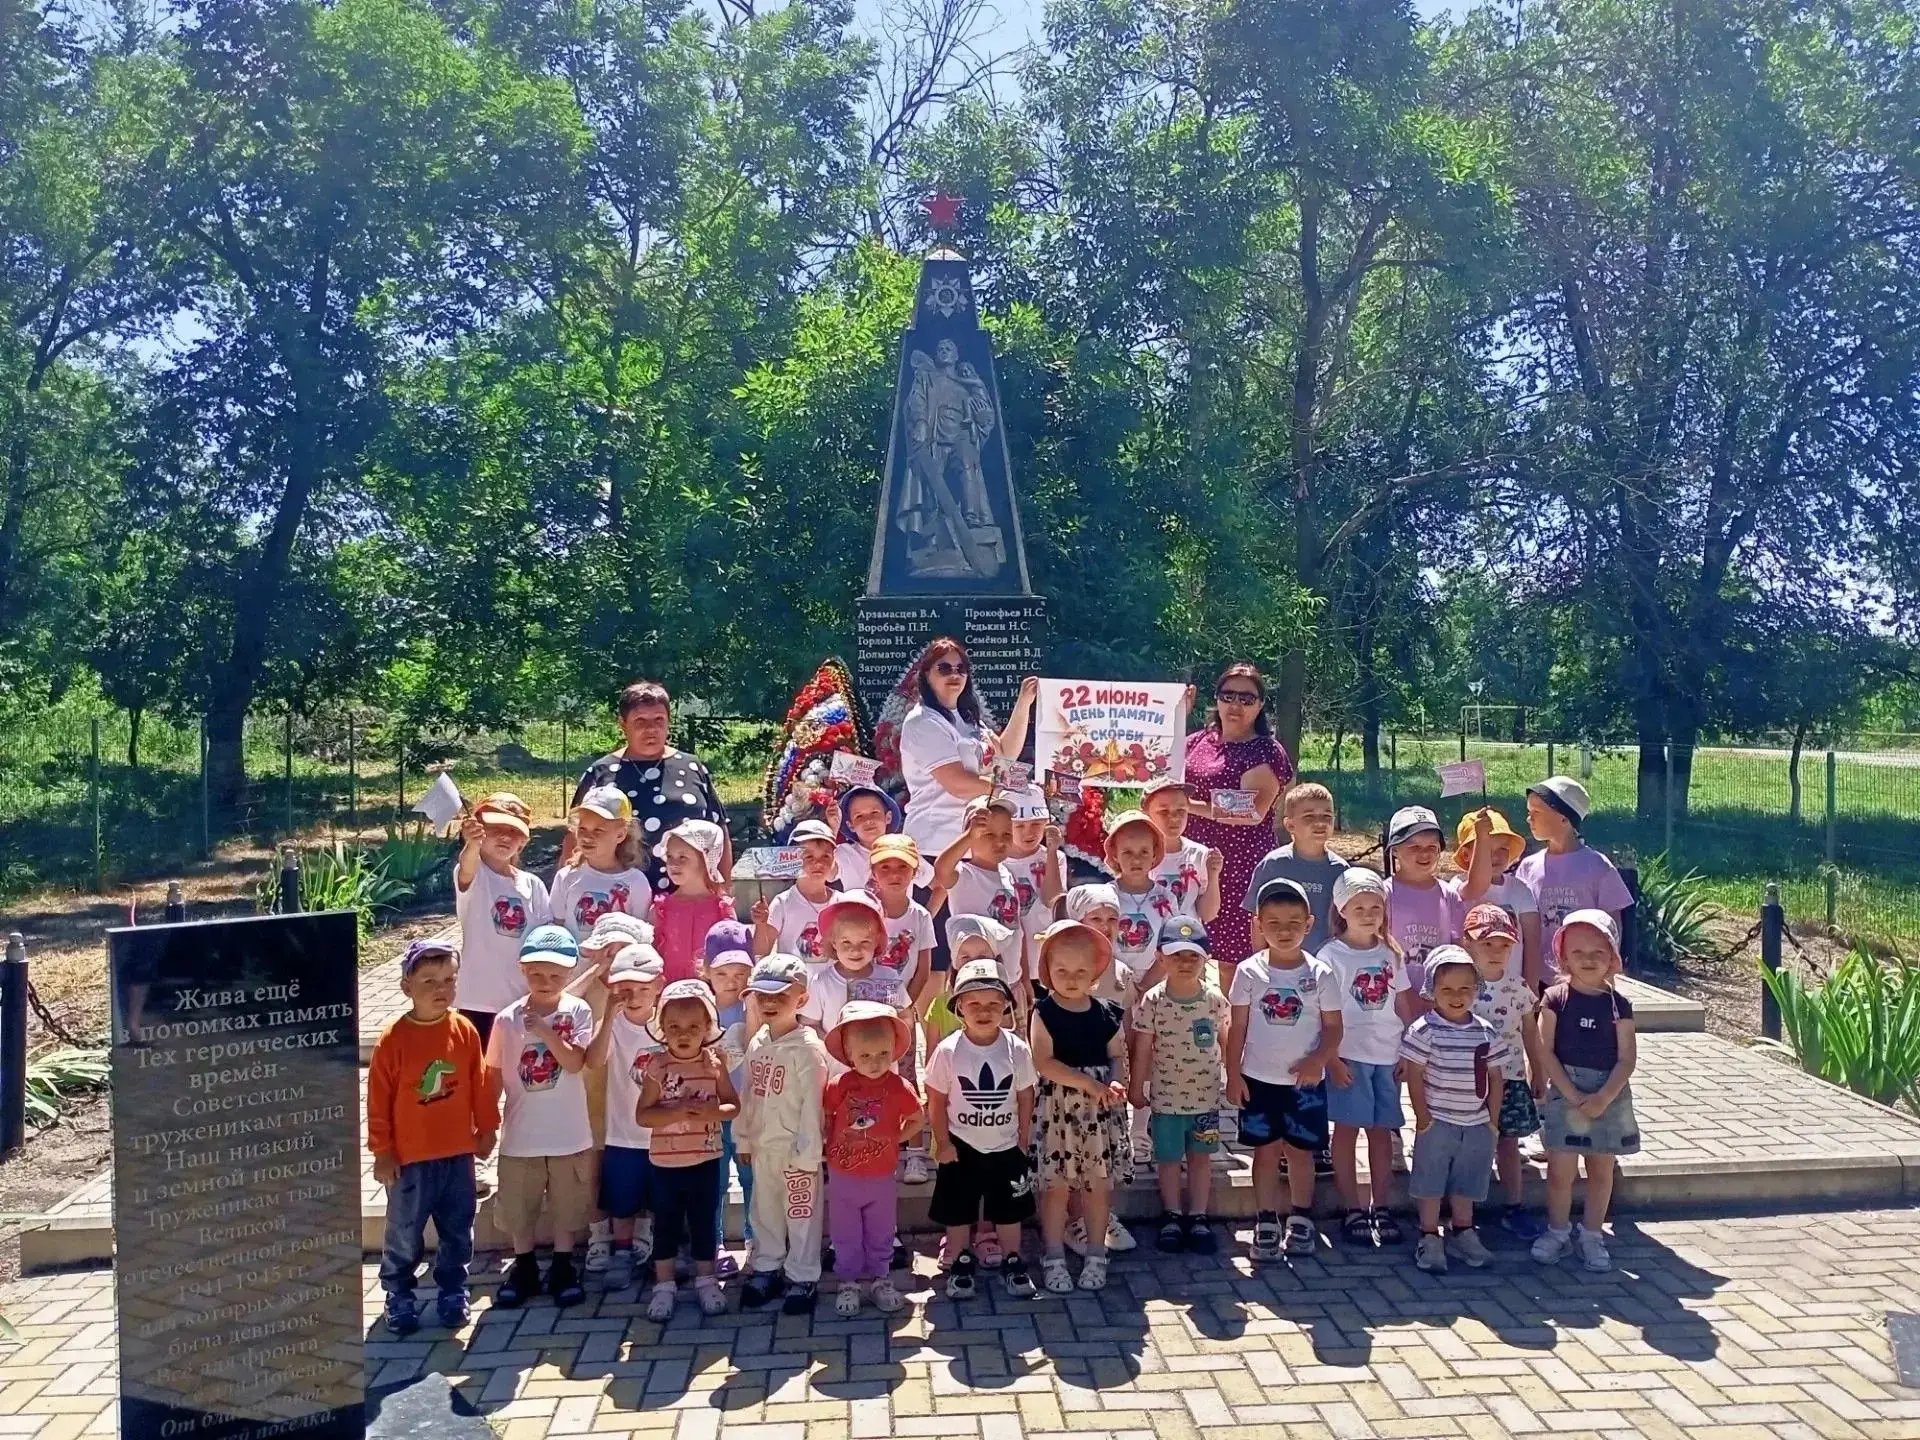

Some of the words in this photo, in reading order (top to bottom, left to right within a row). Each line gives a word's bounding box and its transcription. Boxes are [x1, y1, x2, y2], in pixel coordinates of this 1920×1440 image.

[857, 610, 918, 620] Арзамасцев
[919, 609, 941, 619] В.А.
[964, 608, 1021, 620] Прокофьев
[1022, 607, 1046, 618] Н.С.
[857, 622, 906, 634] Воробьёв
[907, 622, 932, 633] П.Н.
[964, 622, 1006, 632] Редькин
[1008, 621, 1031, 631] Н.С.
[857, 636, 893, 648] Горлов
[894, 636, 917, 646] Н.К.
[964, 635, 1008, 645] Семёнов
[1010, 635, 1033, 645] Н.А.
[857, 650, 907, 661] Долматов
[1023, 648, 1044, 659] В.Д.
[971, 662, 1017, 674] ретьяков
[1019, 661, 1042, 671] Н.С.
[1059, 685, 1092, 709] 22
[1096, 689, 1149, 707] ИЮНЯ
[1069, 708, 1106, 724] ДЕНЬ
[1108, 707, 1166, 726] ПАМЯТИ
[1110, 719, 1119, 728] И
[1089, 728, 1144, 742] СКОРБИ
[174, 988, 247, 1011] Жива
[254, 978, 300, 1002] ещё
[117, 1028, 130, 1044] в
[140, 1012, 260, 1043] потомках
[268, 1002, 353, 1026] память
[1579, 1017, 1597, 1029] ar.
[134, 1047, 177, 1069] Тех
[186, 1029, 339, 1066] героических
[189, 1060, 288, 1093] времён-
[173, 1085, 305, 1117] Советским
[130, 1113, 282, 1153] труженикам
[290, 1104, 345, 1126] тыла
[957, 1111, 1013, 1127] adidas
[166, 1150, 220, 1172] Наш
[229, 1131, 315, 1161] низкий
[157, 1167, 245, 1201] земной
[253, 1149, 345, 1184] поклон!
[144, 1194, 280, 1232] Труженикам
[288, 1182, 336, 1202] тыла
[199, 1214, 287, 1245] Великой
[290, 1230, 356, 1254] войны
[280, 1282, 345, 1308] жизнь
[160, 1418, 195, 1438] От
